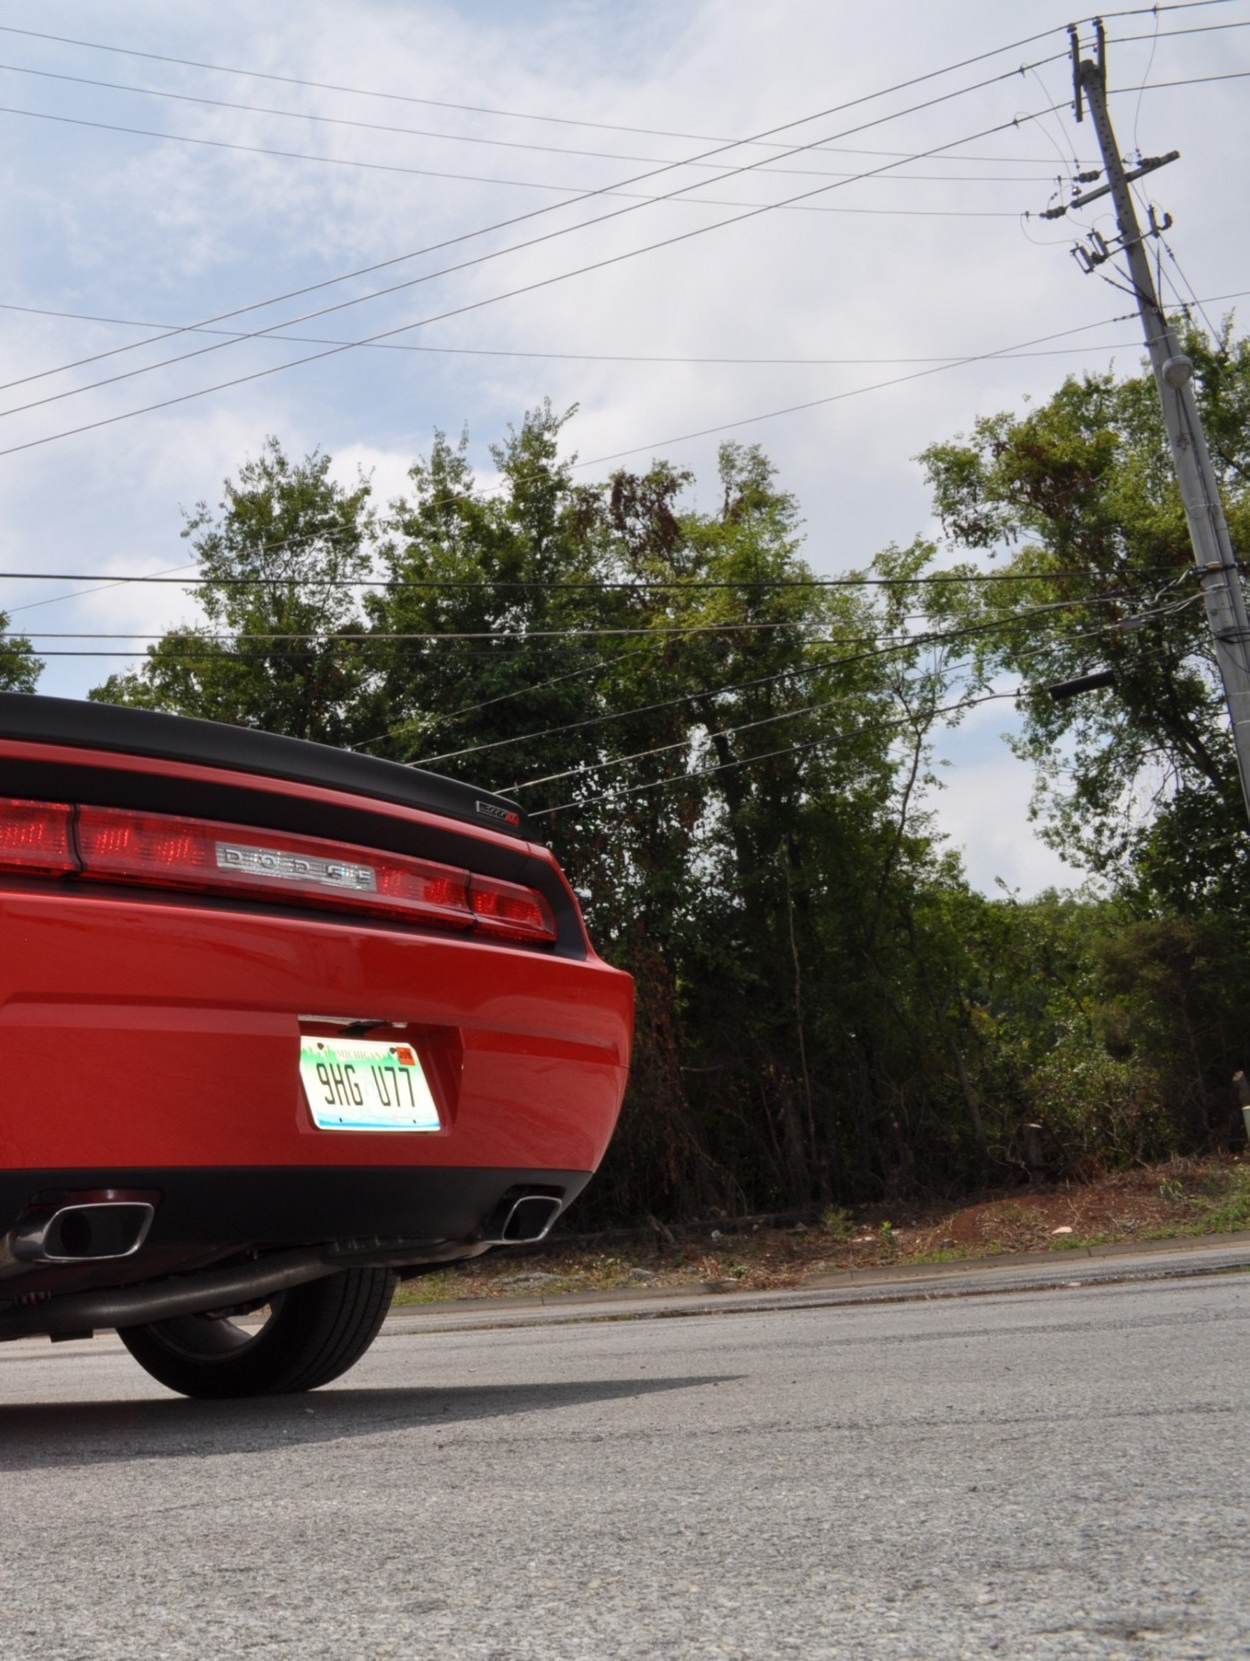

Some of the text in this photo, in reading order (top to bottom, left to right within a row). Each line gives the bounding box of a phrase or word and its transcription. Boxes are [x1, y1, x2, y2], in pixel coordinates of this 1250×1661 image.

[224, 849, 371, 885] DODGE
[316, 1063, 416, 1107] 9HG U77
